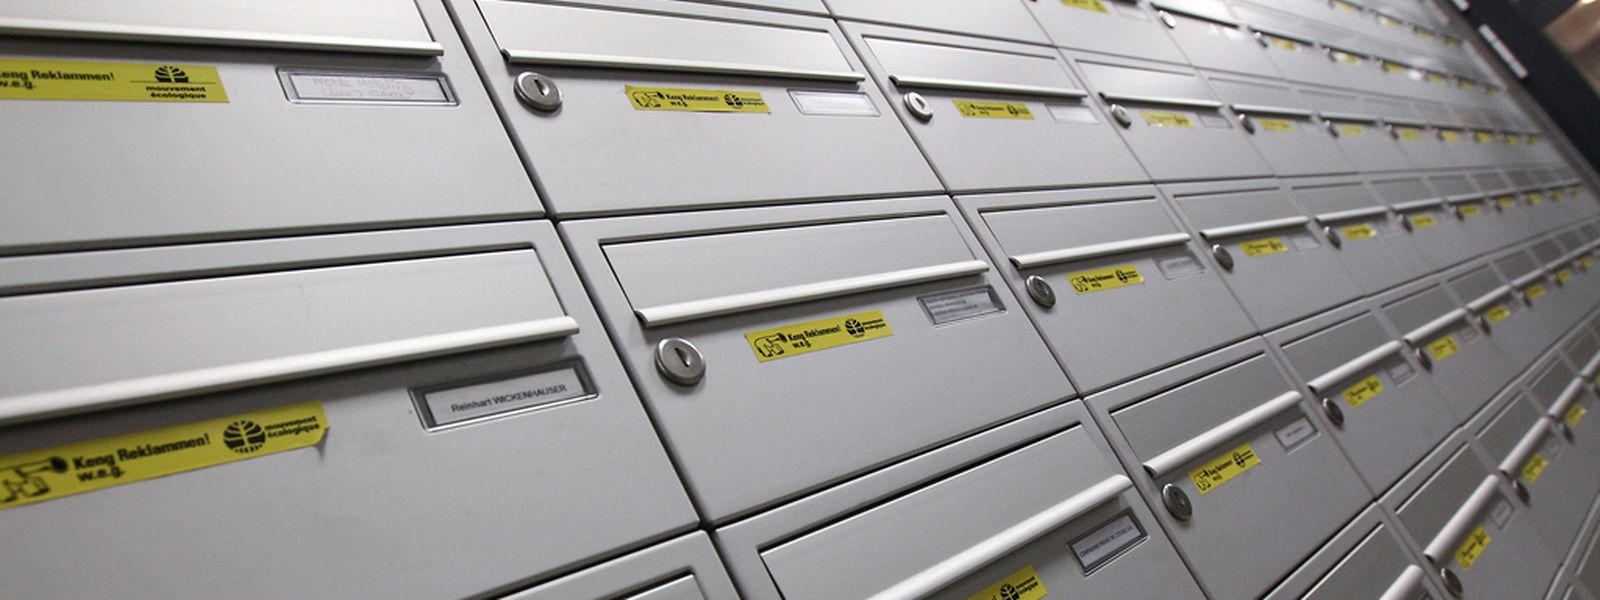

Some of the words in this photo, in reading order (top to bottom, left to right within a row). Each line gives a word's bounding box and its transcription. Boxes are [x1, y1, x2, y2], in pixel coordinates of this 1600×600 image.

[0, 70, 28, 81] eng
[30, 69, 114, 82] Reklammen!
[145, 85, 206, 93] mouvement
[149, 91, 207, 99] écologique
[451, 398, 492, 413] Reinhart
[492, 384, 568, 404] WICKENHAUSER
[265, 415, 317, 431] mouvement
[267, 422, 320, 439] écologique
[73, 453, 116, 471] Keng
[117, 433, 211, 463] Reklammen!
[77, 465, 125, 482] w.e.g.
